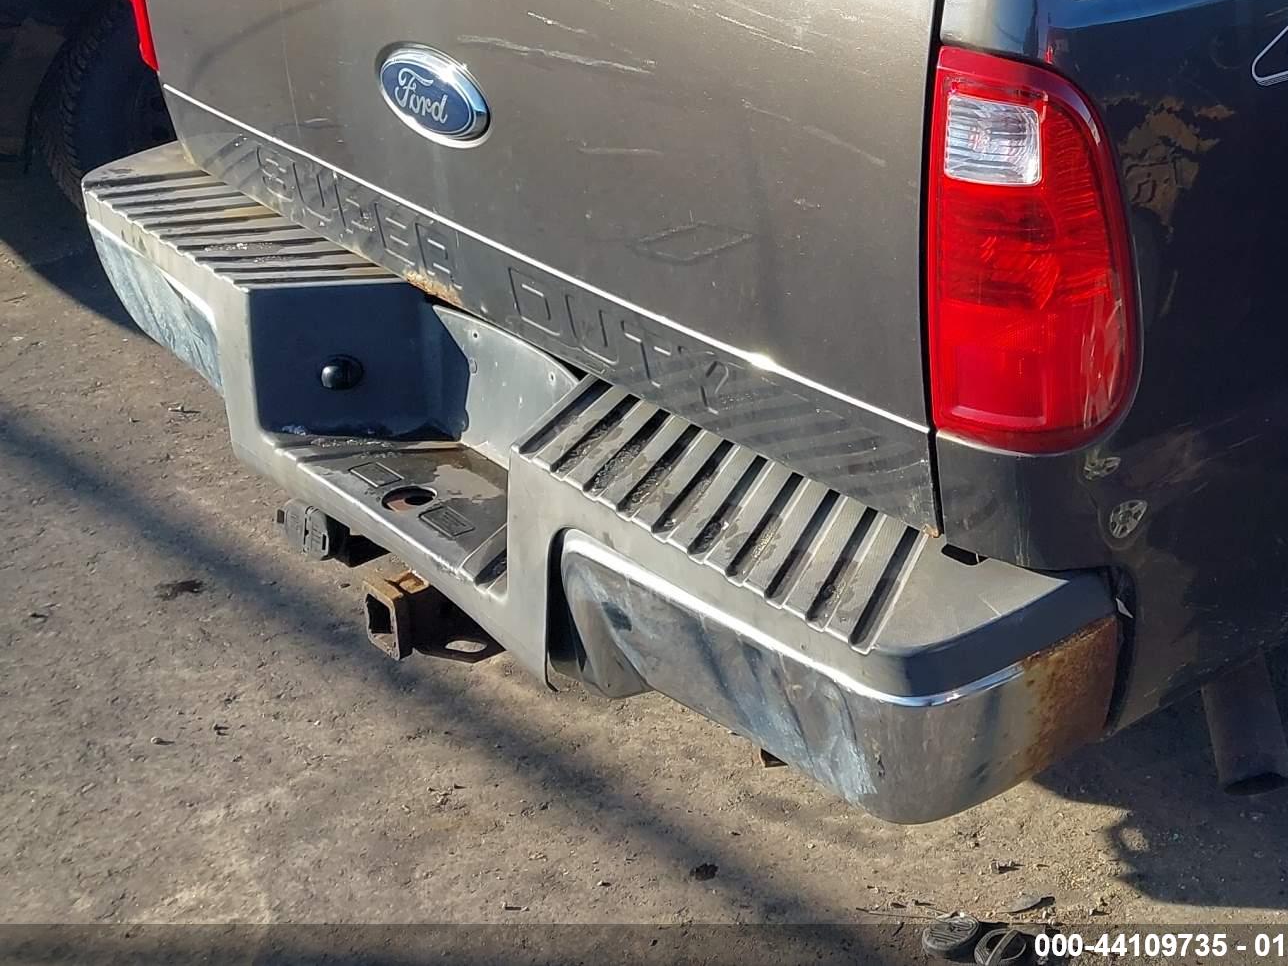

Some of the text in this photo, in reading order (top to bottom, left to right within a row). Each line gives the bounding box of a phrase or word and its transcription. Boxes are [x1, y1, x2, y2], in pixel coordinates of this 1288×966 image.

[394, 67, 449, 124] Ford
[256, 141, 744, 415] SUPER DUTY
